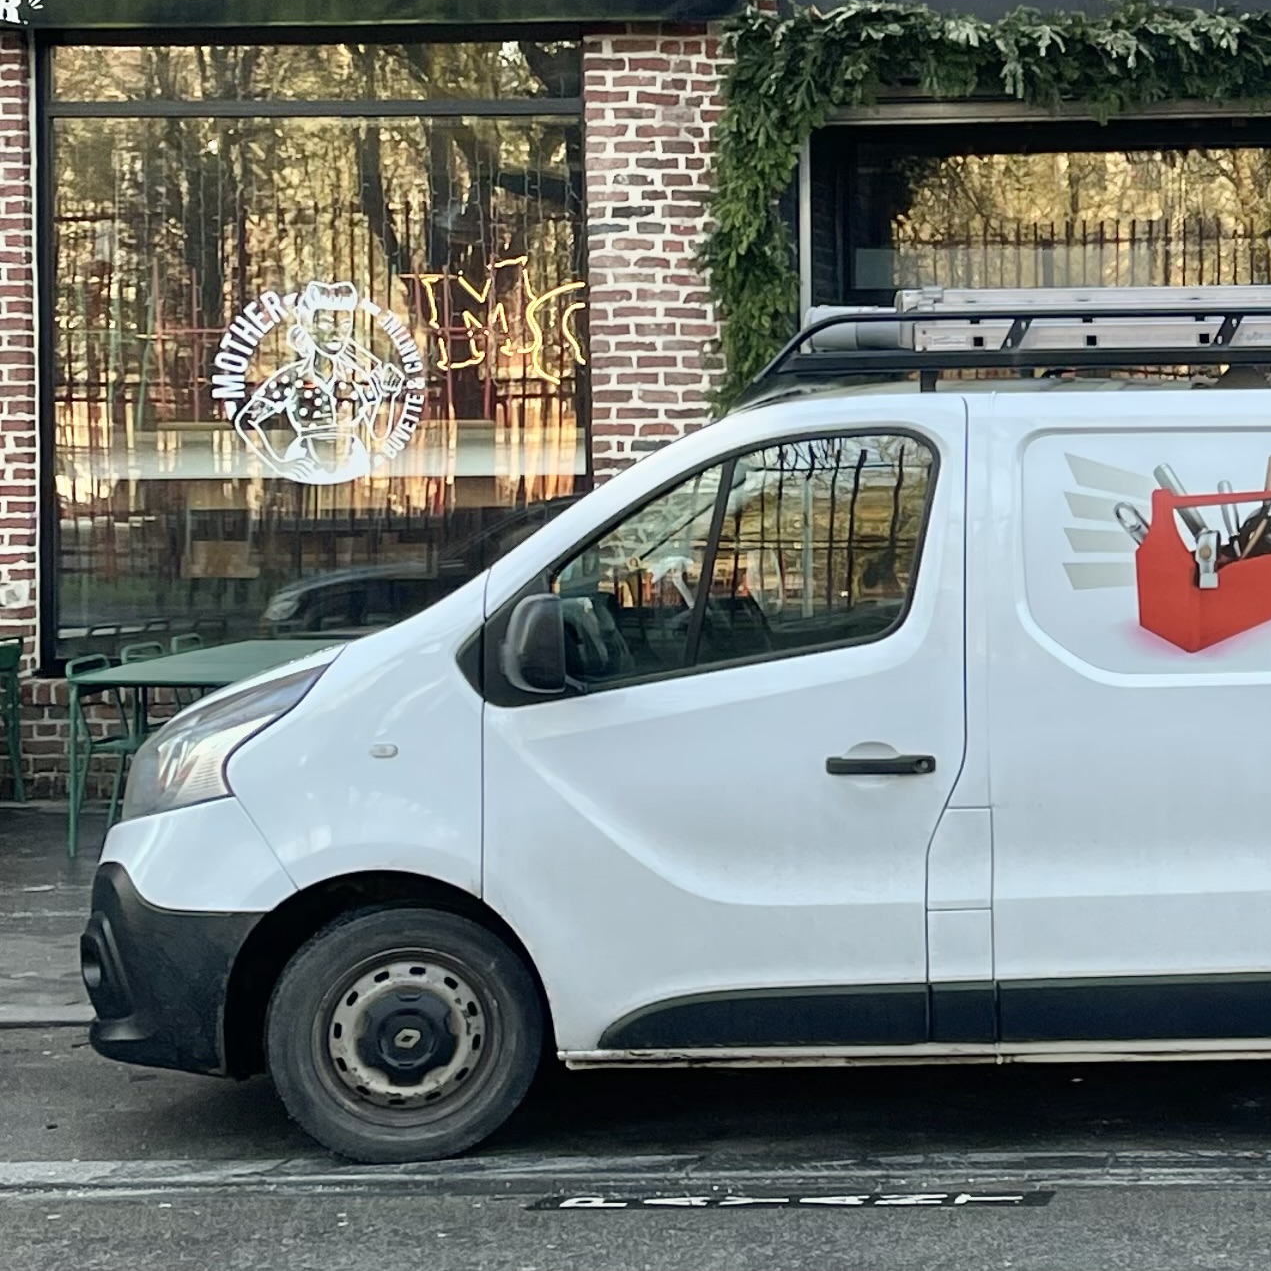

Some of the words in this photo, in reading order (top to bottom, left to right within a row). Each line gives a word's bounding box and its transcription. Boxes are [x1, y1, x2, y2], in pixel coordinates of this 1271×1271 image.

[211, 290, 289, 399] MOTHER
[377, 309, 423, 374] CANTINE
[381, 392, 425, 460] BUVETTE
